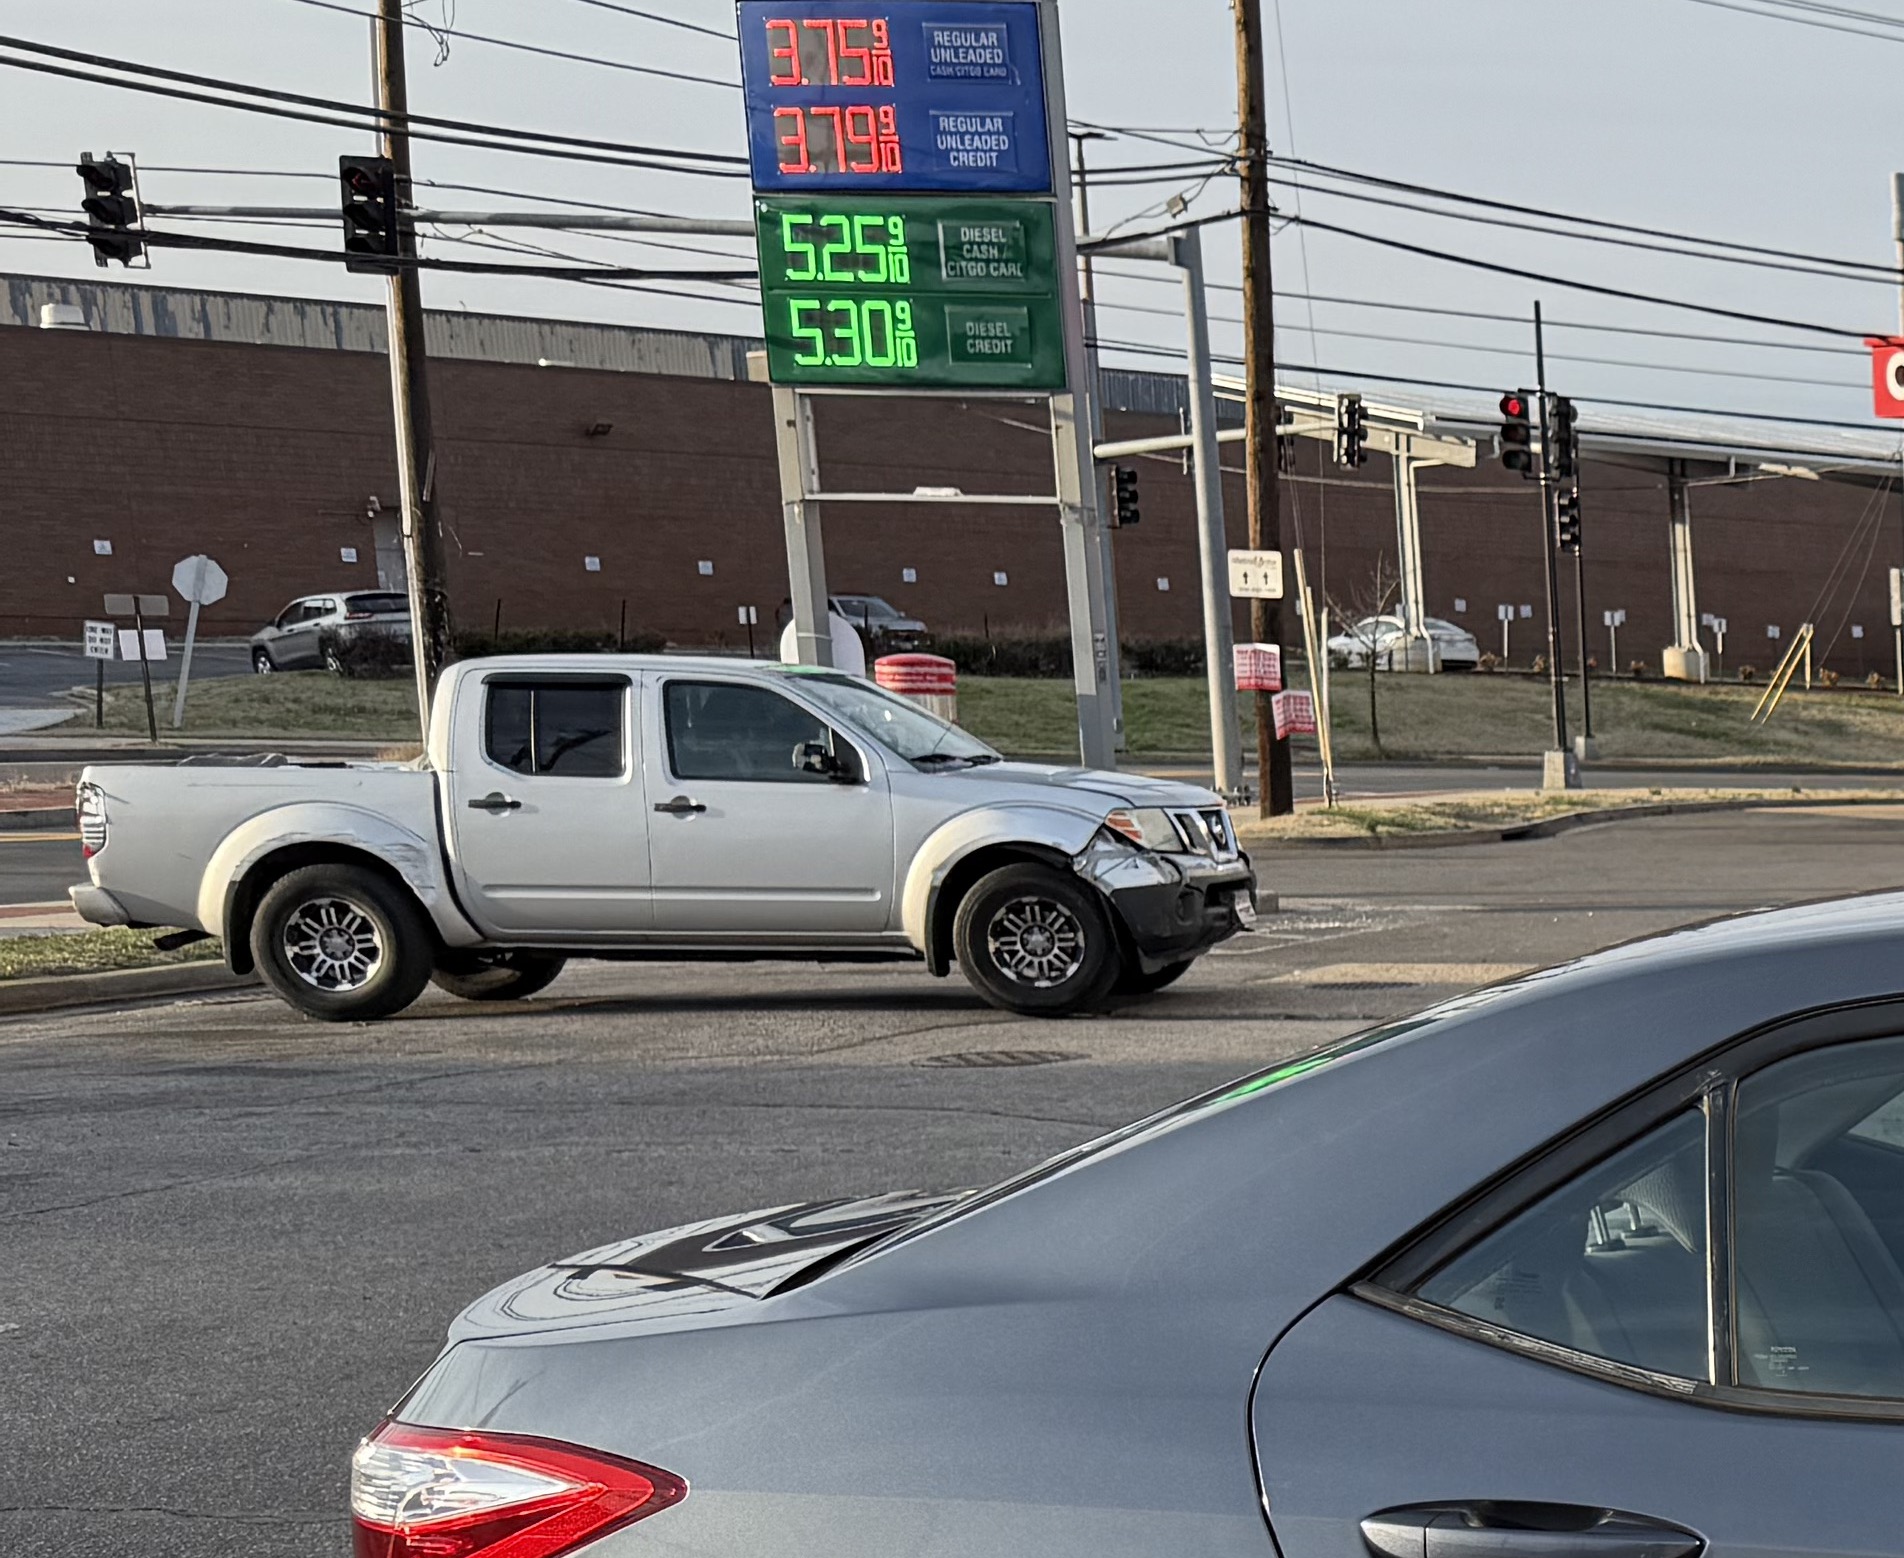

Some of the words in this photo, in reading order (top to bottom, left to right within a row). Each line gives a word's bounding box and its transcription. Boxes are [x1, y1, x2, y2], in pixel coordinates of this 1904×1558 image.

[933, 30, 998, 46] REGULAR
[766, 19, 872, 85] 3.75
[930, 48, 1003, 64] UNLEADED
[939, 117, 1003, 132] REGULAR
[774, 106, 880, 173] 3.79
[937, 134, 1009, 150] UNLEADED
[950, 151, 998, 167] CREDIT
[961, 227, 1007, 243] DIESEL
[782, 214, 888, 282] 5.25
[963, 244, 999, 259] CASH
[947, 261, 987, 276] CITGO
[790, 300, 895, 367] 5.30
[966, 322, 1011, 337] DIESEL
[966, 339, 1013, 354] CREDIT
